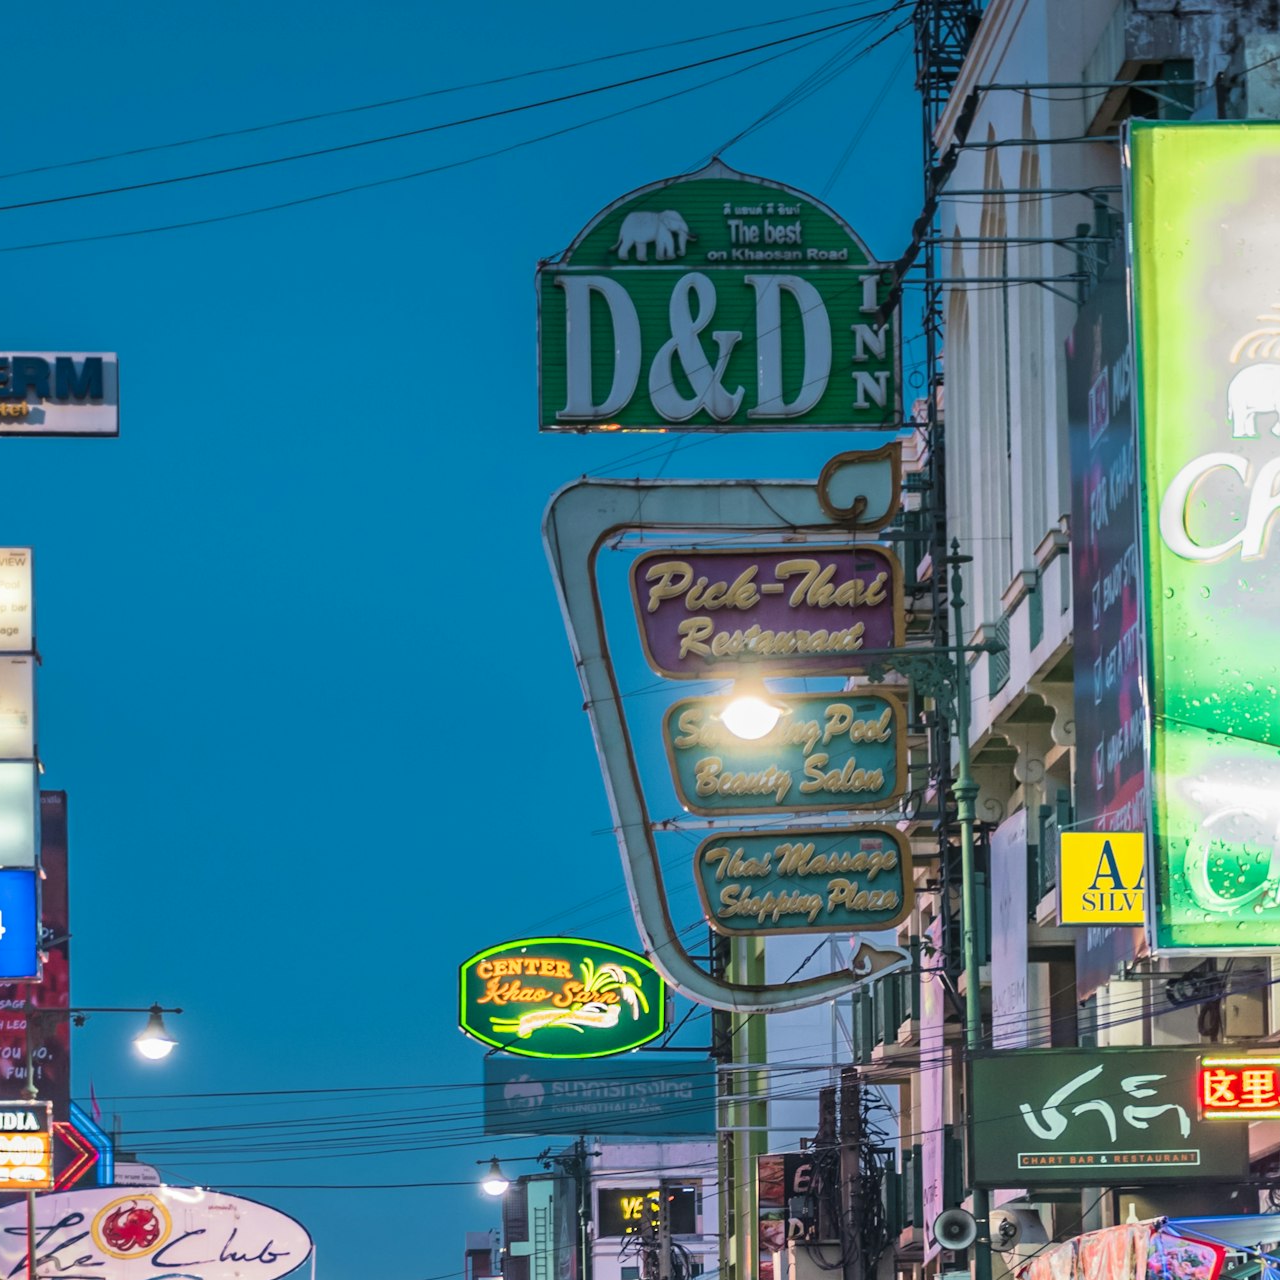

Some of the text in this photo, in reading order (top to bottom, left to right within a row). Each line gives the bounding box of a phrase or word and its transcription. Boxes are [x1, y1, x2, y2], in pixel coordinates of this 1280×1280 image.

[727, 219, 802, 244] The best
[707, 247, 848, 261] on Khaosan Road
[554, 272, 832, 422] D&D
[851, 274, 890, 409] INN
[644, 560, 888, 614] Pick-Thai
[678, 617, 866, 660] Restaurant
[824, 703, 892, 745] Pool
[695, 754, 884, 802] Beauty Salon
[706, 843, 898, 882] Thai Massage
[718, 879, 899, 922] Shopping Plaza
[1082, 892, 1145, 911] SILV
[477, 958, 573, 979] CENTER
[477, 976, 621, 1008] Khao Sarn
[6, 1019, 27, 1029] LEO
[1021, 1152, 1197, 1166] CHART BAR & RESTAURANT
[4, 1212, 291, 1278] The Club
